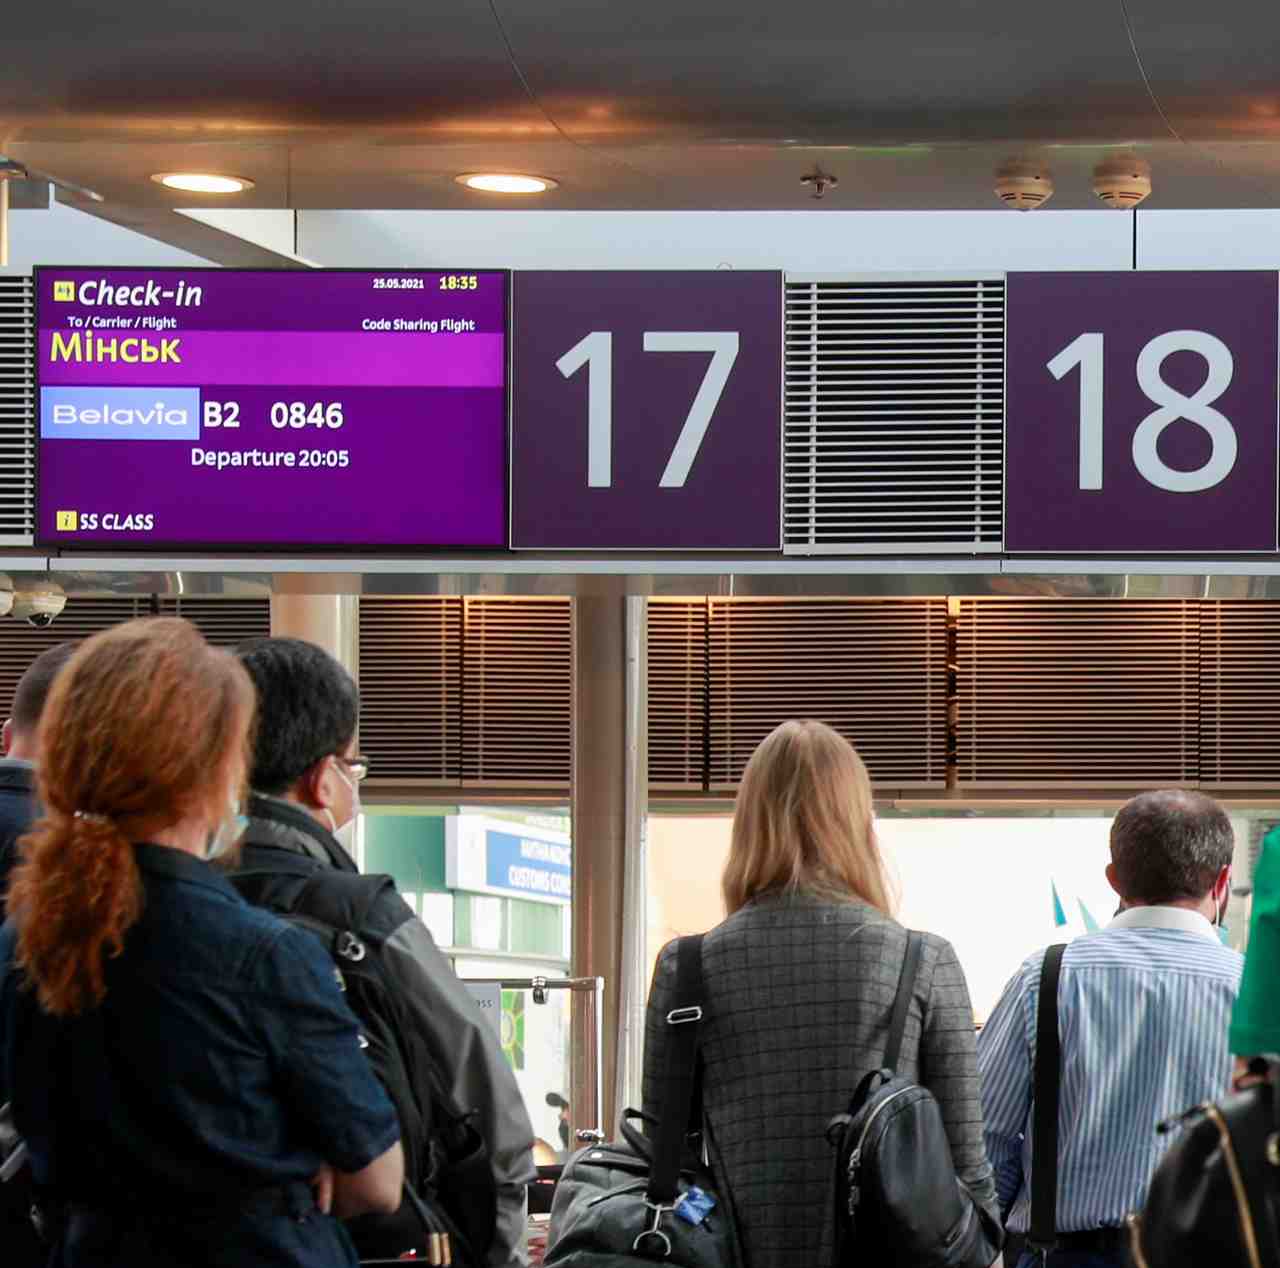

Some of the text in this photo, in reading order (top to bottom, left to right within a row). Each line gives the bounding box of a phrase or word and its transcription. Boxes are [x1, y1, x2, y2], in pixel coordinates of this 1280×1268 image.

[79, 280, 201, 306] Check-in
[373, 276, 477, 289] 25.05.2021 18:35
[68, 317, 83, 327] To
[92, 316, 132, 327] Carrier
[143, 317, 176, 330] Flight
[363, 319, 475, 333] Code Sharing Flight
[51, 331, 180, 362] Мінськ
[52, 401, 343, 428] Belavia B2 0846
[556, 332, 739, 487] 17
[1047, 330, 1237, 492] 18
[192, 448, 348, 470] Departure 20:05
[102, 514, 153, 530] CLASS
